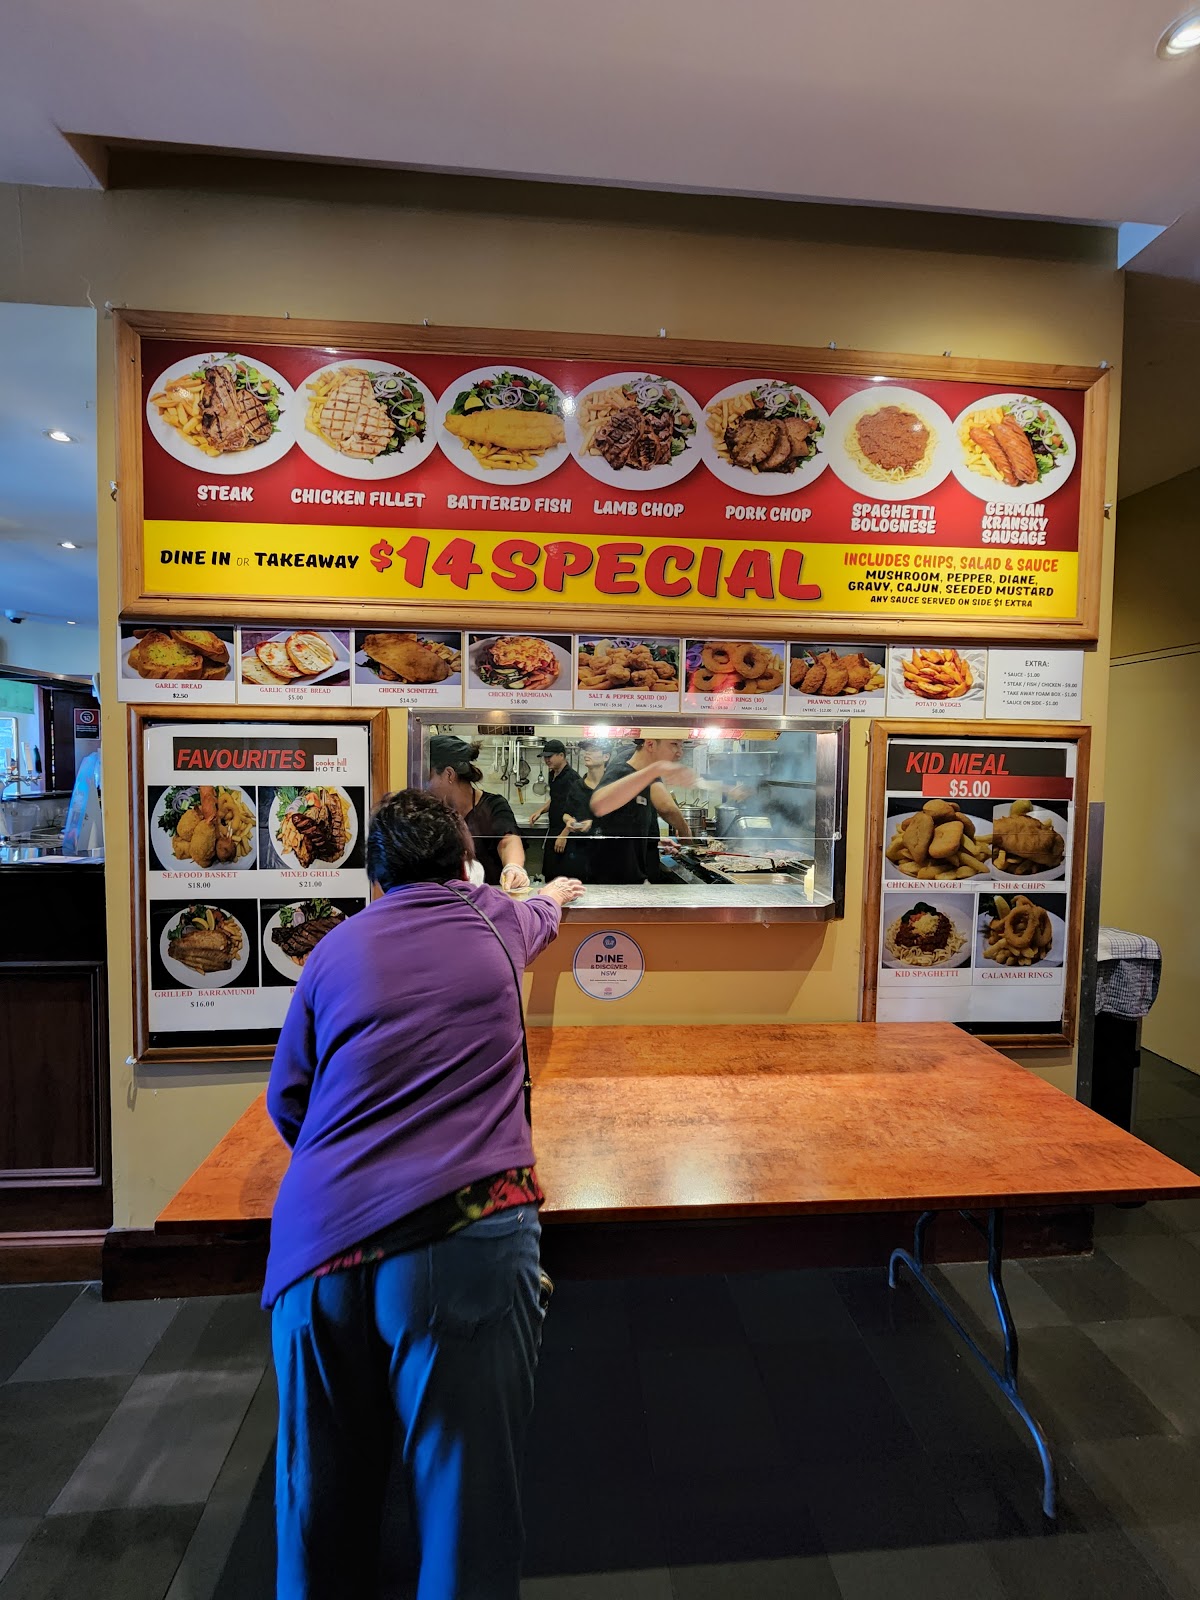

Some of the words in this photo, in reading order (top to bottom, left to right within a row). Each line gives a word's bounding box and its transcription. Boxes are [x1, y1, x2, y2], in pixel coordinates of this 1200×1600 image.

[197, 485, 254, 501] STEAK
[291, 488, 365, 505] CHICKEN
[369, 491, 426, 508] FILLET
[447, 495, 530, 511] BATTERED
[534, 497, 572, 513] FISH
[593, 500, 638, 516] LAMB
[641, 502, 684, 518] CHOP
[852, 503, 935, 520] SPAGHETTI
[985, 502, 1045, 517] GERMAN
[725, 505, 767, 521] PORK
[770, 506, 812, 522] CHOP
[851, 517, 936, 534] BOLOGNESE
[981, 516, 1048, 532] KRANSKY
[981, 530, 1046, 545] SAUSAGE
[160, 550, 206, 565] DINE
[211, 551, 231, 566] IN
[236, 557, 250, 567] OR
[254, 552, 359, 569] TAKEAWAY
[844, 552, 910, 567] INCLUDES
[914, 554, 956, 570] CHIPS,
[960, 556, 1001, 570] SALAD
[1005, 559, 1013, 571] &
[1017, 559, 1058, 572] SAUCE
[370, 536, 482, 590] $14
[491, 539, 821, 600] SPECIAL
[865, 570, 942, 583] MUSHROOM,
[947, 573, 995, 584] PEPPER,
[999, 574, 1037, 585] DIANE,
[848, 581, 893, 593] GRAVY,
[897, 583, 941, 594] CAJUN,
[945, 584, 992, 594] SEEDED
[996, 586, 1054, 596] MUSTARD
[870, 595, 887, 603] ANY
[890, 596, 919, 604] SAUCE
[922, 597, 955, 605] SERVED
[972, 598, 992, 606] SIDE
[994, 598, 1002, 607] $1
[1005, 599, 1032, 607] EXTRA
[176, 749, 307, 769] FAVOURITES
[315, 758, 335, 766] cooks
[337, 758, 347, 766] hill
[906, 752, 944, 774] KID
[949, 753, 1010, 776] MEAL
[949, 778, 991, 798] $5.00
[162, 871, 202, 879] SEAFOOD
[188, 882, 211, 890] $18.00
[298, 880, 322, 888] $21.00
[596, 954, 623, 963] DINE
[154, 990, 193, 998] GRILLED
[198, 988, 256, 996] BARRAMUNDI
